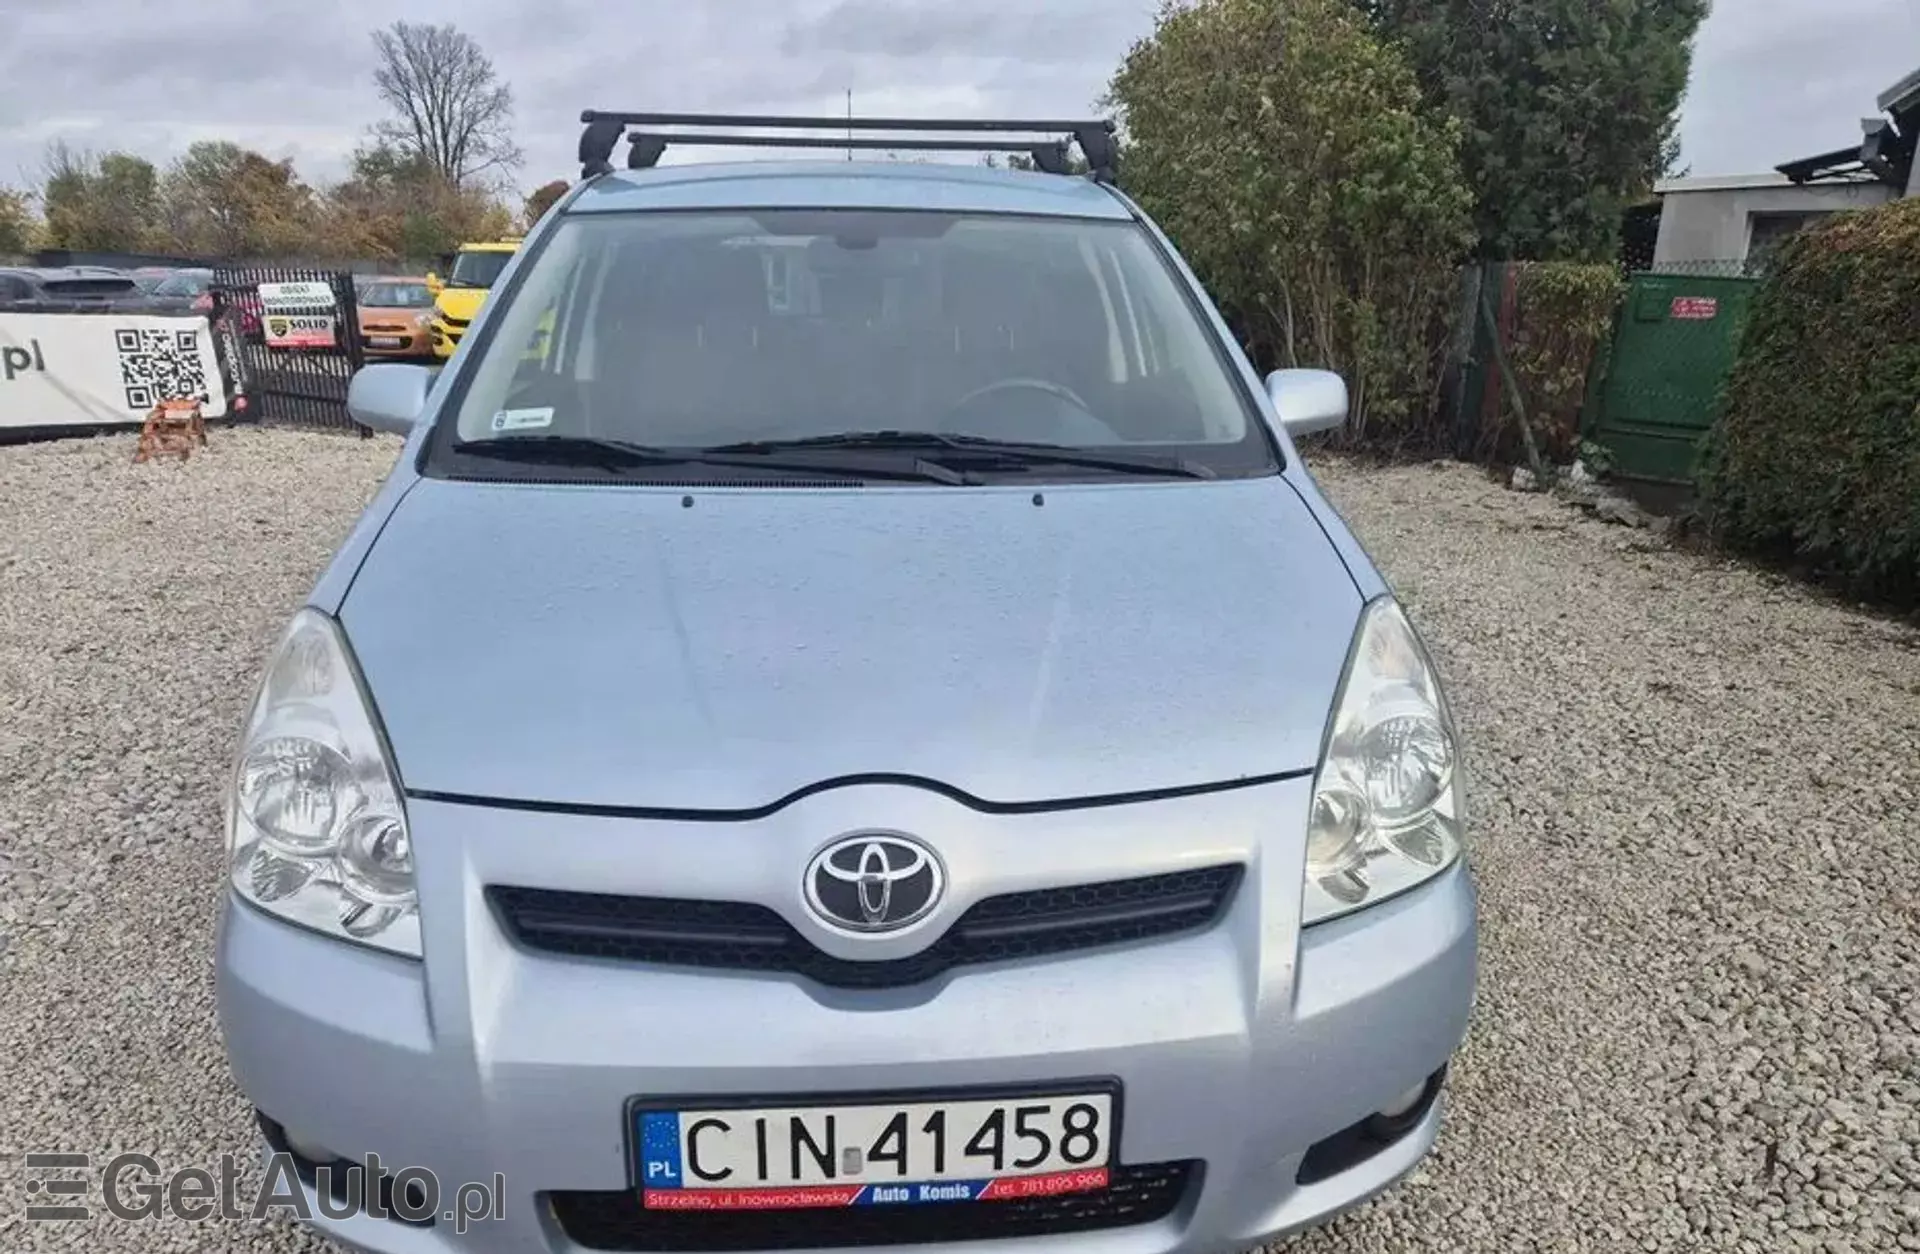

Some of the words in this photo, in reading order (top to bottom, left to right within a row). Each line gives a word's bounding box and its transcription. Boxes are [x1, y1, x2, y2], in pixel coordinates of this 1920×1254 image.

[687, 1115, 836, 1182] CIN
[867, 1103, 1099, 1176] 41458
[649, 1162, 676, 1178] PL
[649, 1193, 715, 1209] Strzelno,
[872, 1186, 910, 1202] Auto
[919, 1184, 970, 1200] Komis
